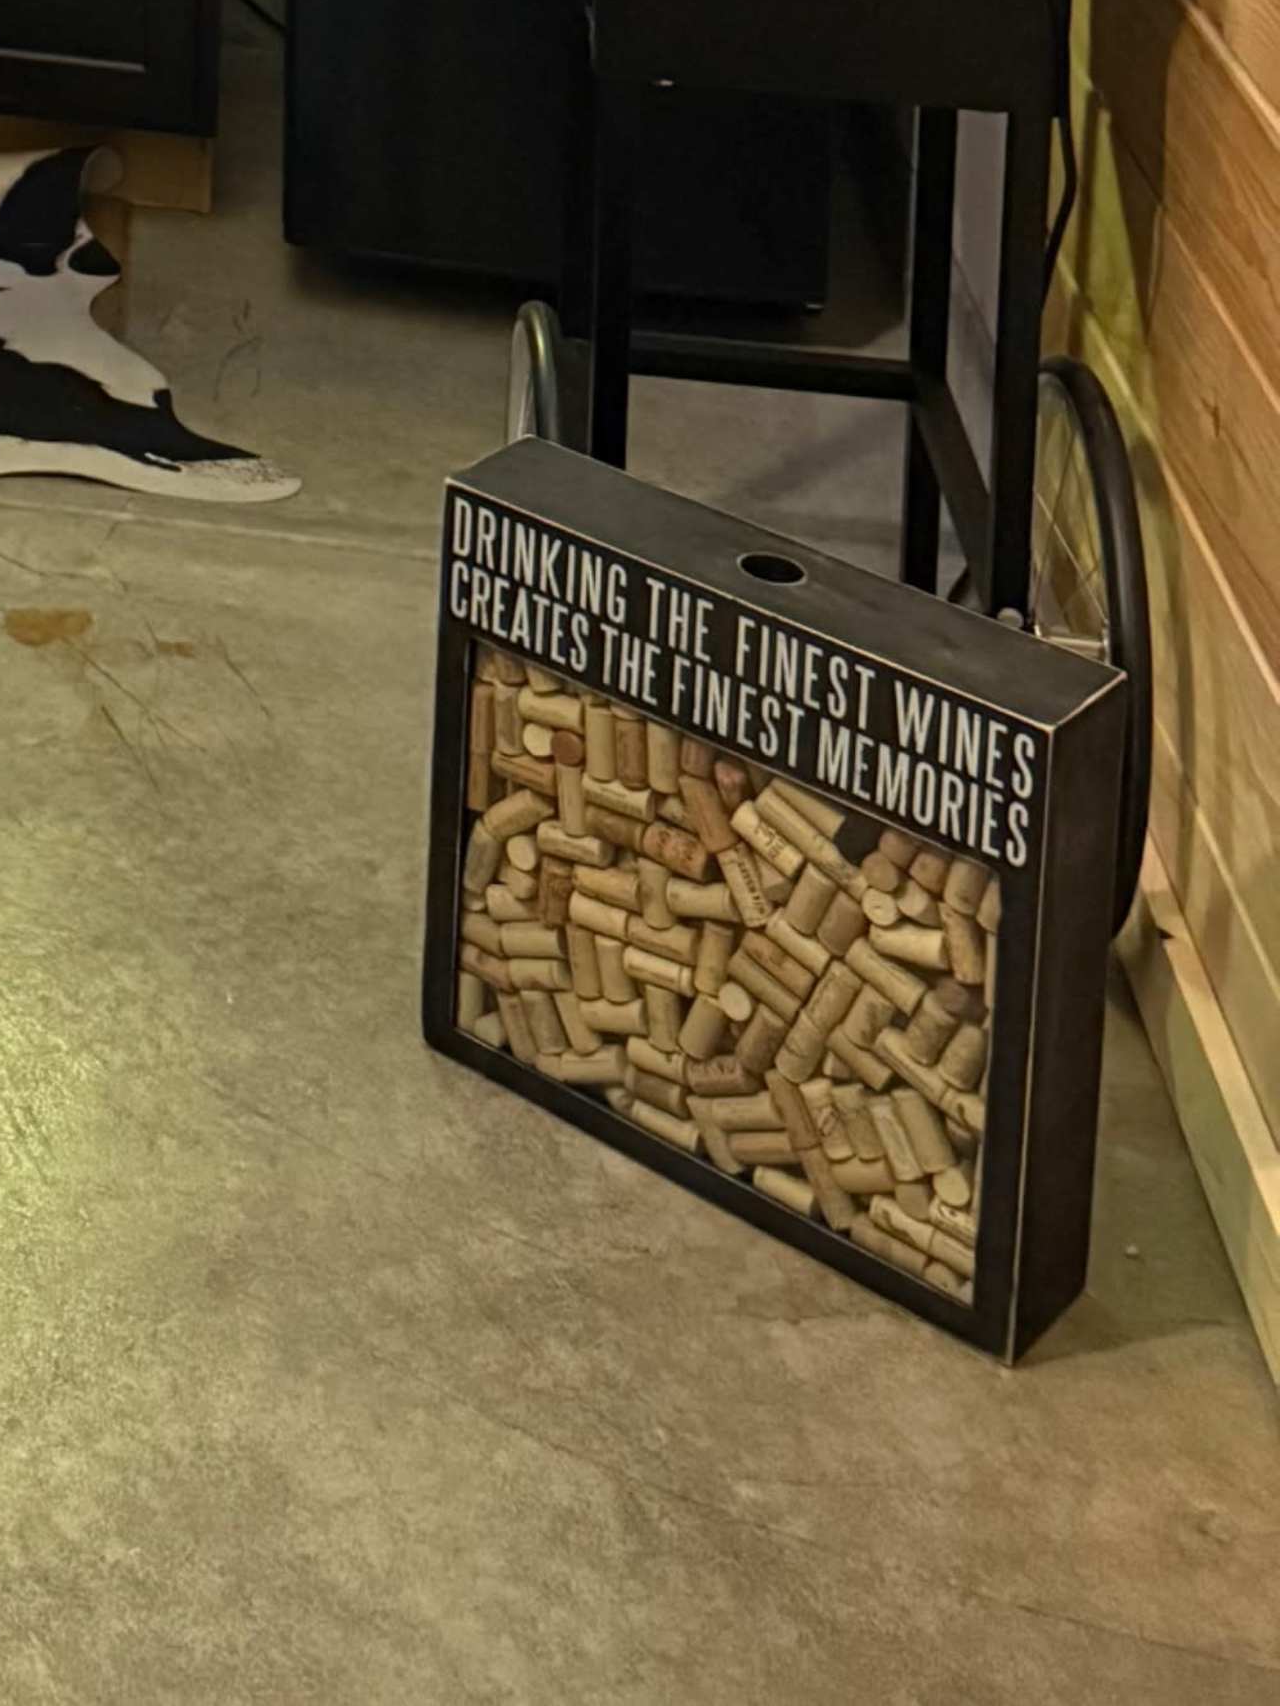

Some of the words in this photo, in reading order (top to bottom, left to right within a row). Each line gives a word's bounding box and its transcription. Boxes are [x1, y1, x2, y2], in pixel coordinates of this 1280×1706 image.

[449, 559, 590, 674] CREATES
[600, 622, 663, 706] THE
[671, 655, 806, 769] FINEST
[816, 717, 1030, 868] MEMORIES
[452, 495, 628, 625] DRINKING
[645, 576, 715, 664] THE
[735, 614, 877, 731] FINEST
[893, 679, 1037, 800] WINES
